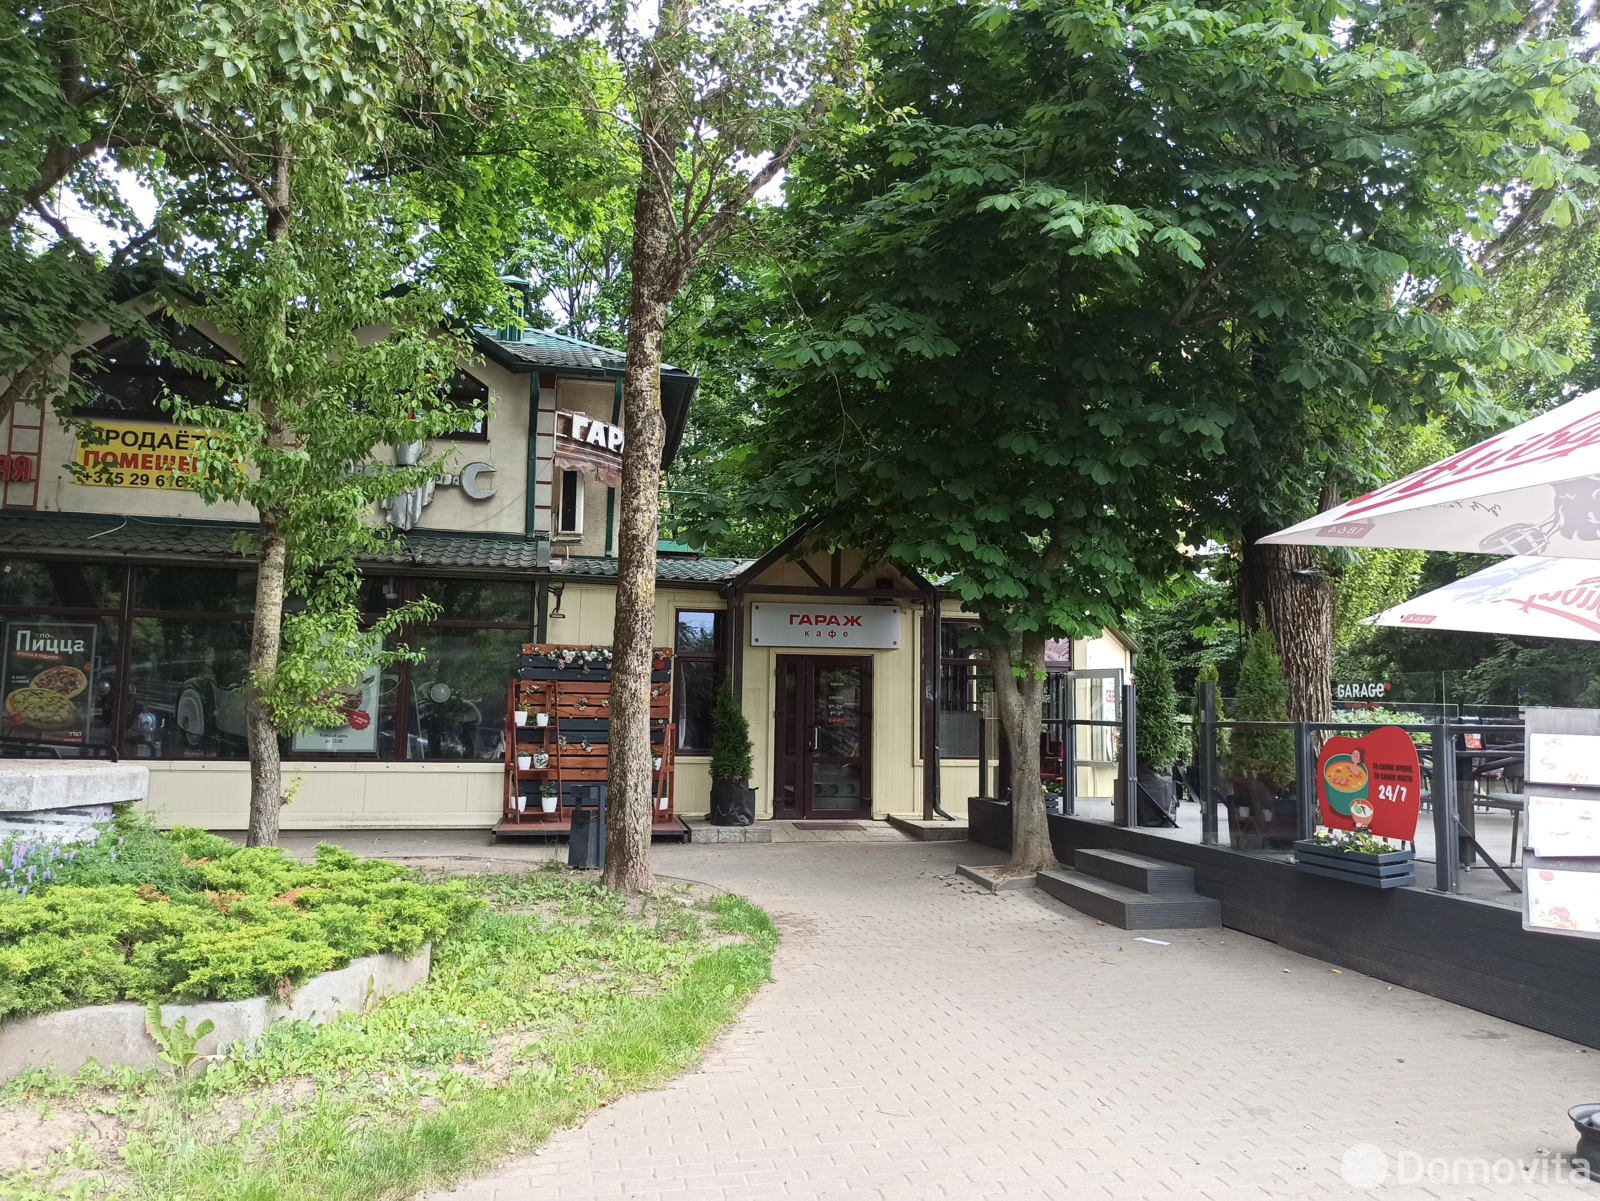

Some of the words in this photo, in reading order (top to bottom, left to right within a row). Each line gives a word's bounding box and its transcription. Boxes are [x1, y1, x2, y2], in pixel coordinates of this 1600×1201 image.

[572, 414, 624, 453] ГАР
[129, 473, 150, 486] 29
[789, 614, 863, 627] ГАРАЖ
[804, 629, 849, 639] кафе
[16, 630, 85, 655] Пицца
[1378, 784, 1407, 803] 24/7
